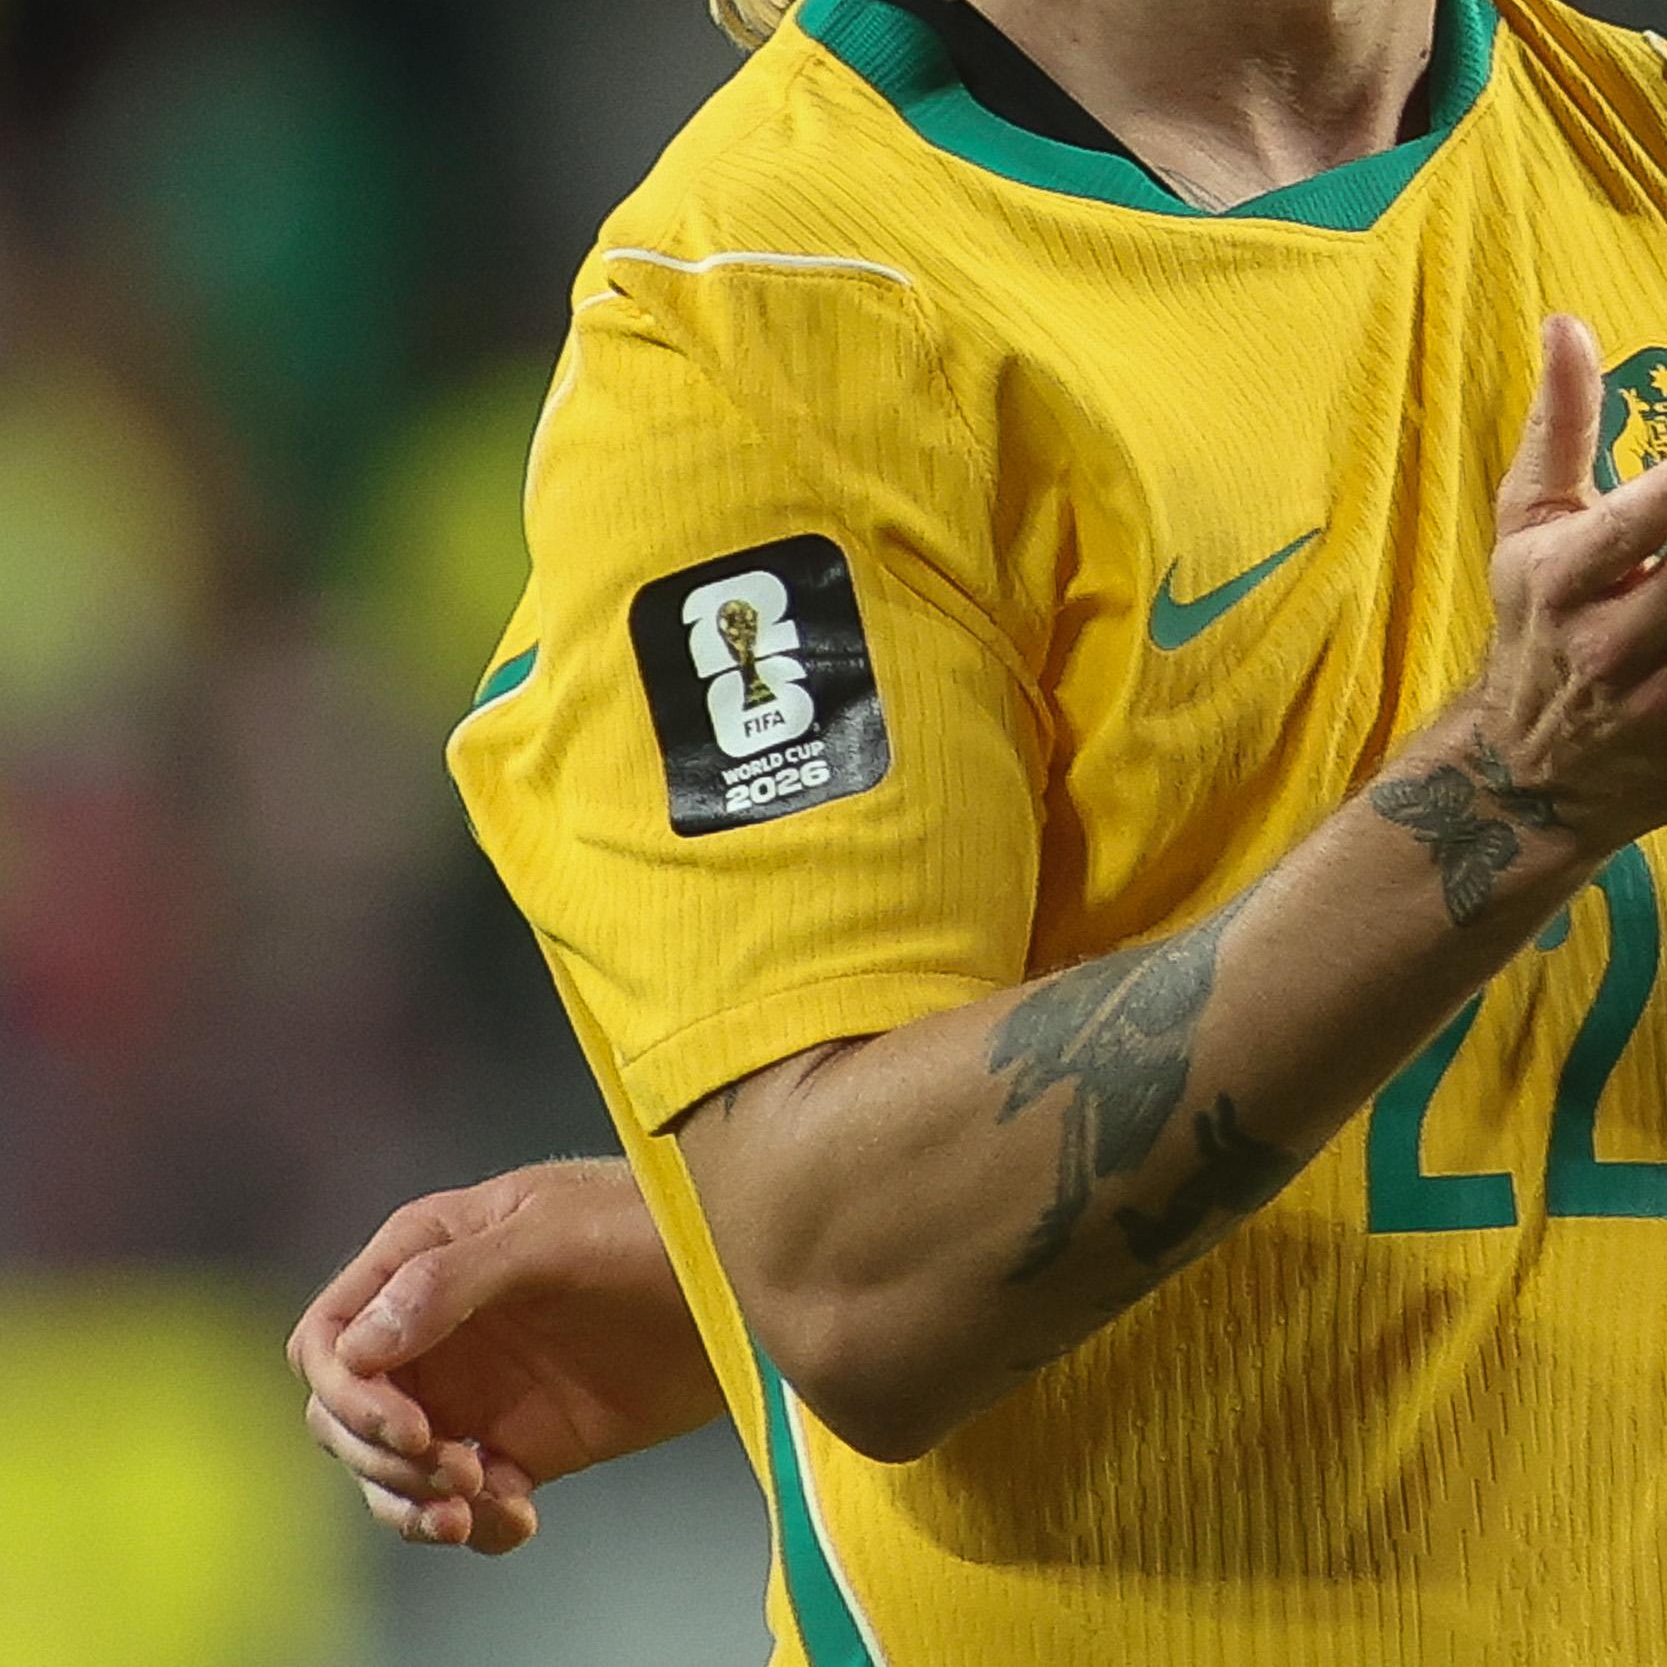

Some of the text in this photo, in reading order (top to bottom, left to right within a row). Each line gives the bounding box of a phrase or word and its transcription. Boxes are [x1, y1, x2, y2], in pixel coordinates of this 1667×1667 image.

[744, 711, 785, 738] FIFA
[721, 740, 825, 785] WORLD CUP
[726, 760, 831, 813] 2026
